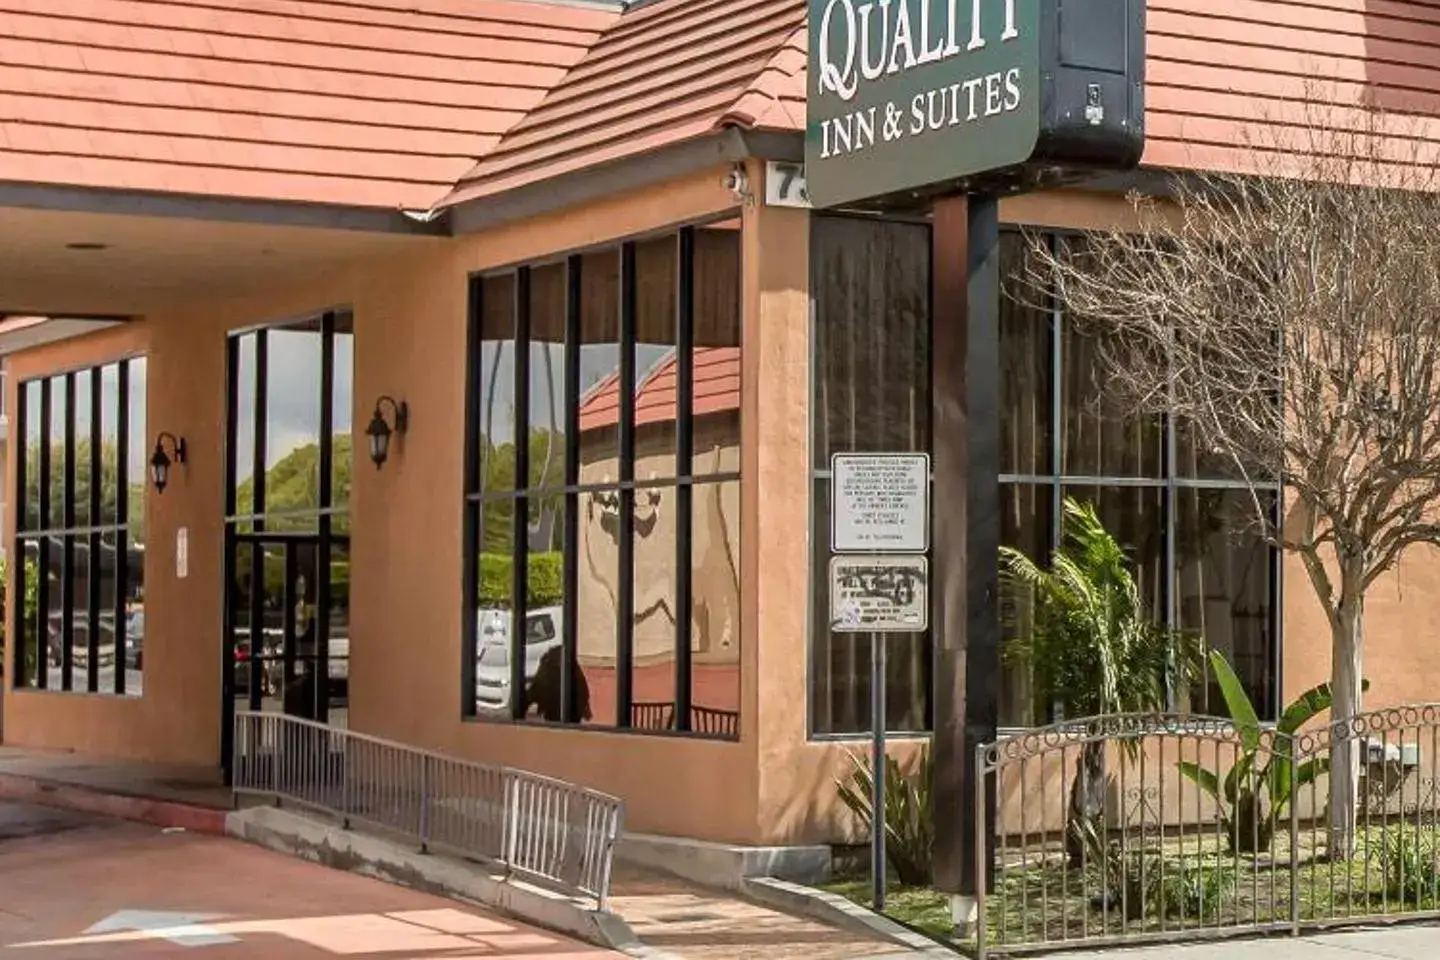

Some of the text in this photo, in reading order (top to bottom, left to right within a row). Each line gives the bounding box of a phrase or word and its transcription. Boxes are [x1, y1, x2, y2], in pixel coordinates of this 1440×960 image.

[820, 68, 1021, 159] INN & SUITES
